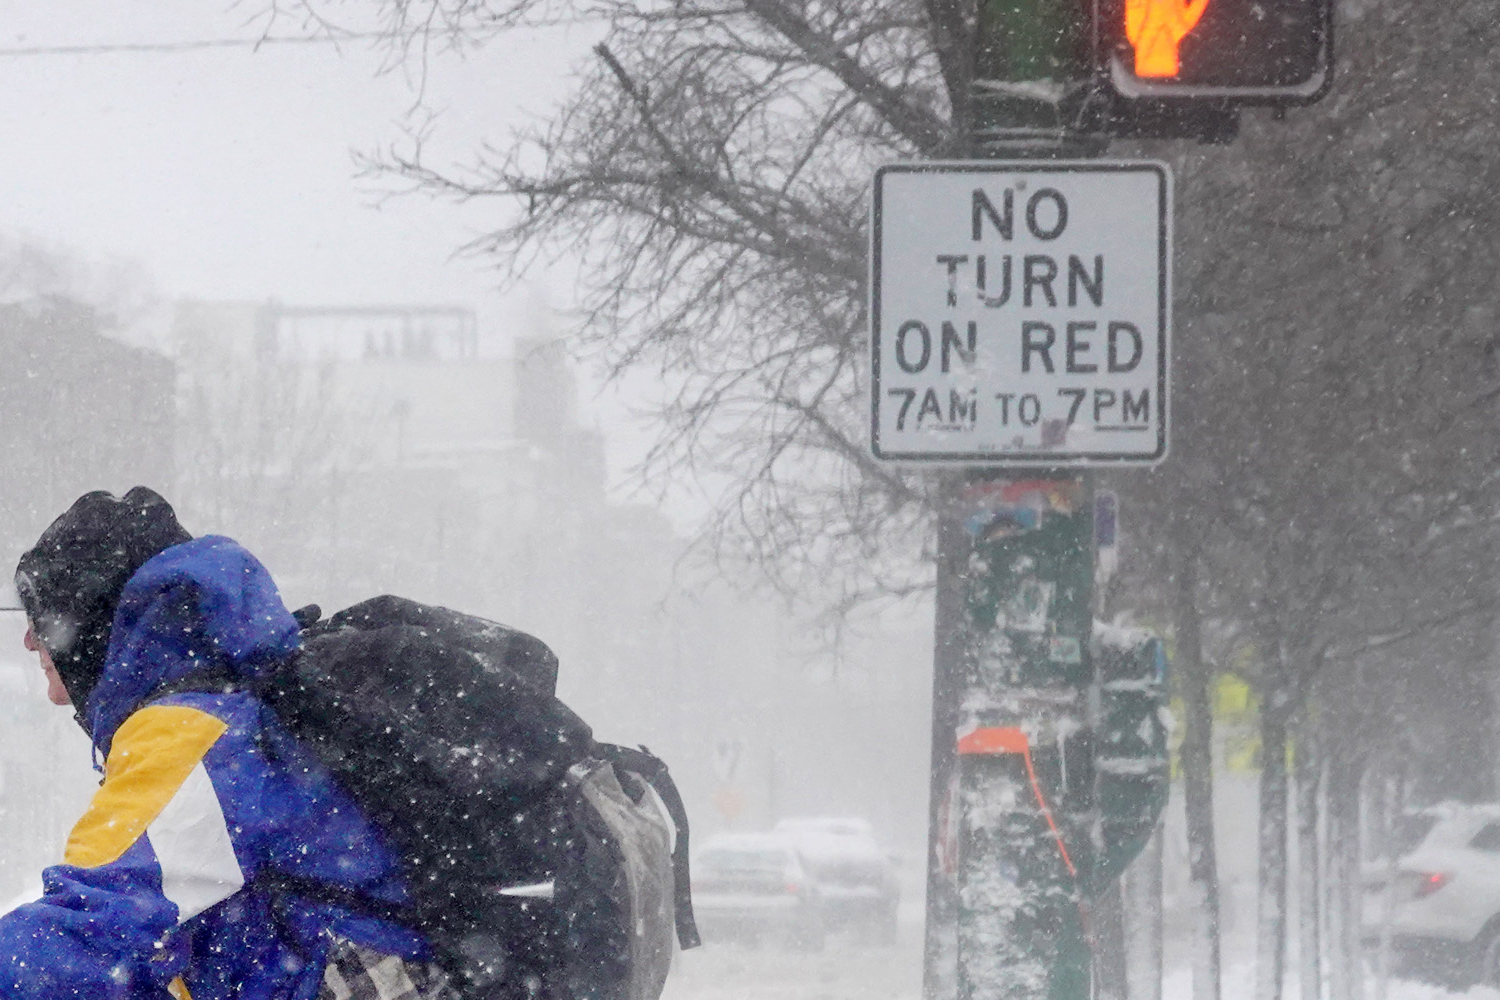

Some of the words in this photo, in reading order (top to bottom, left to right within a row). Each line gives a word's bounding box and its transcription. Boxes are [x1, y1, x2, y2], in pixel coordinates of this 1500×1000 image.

[972, 187, 1068, 241] NO
[936, 254, 1104, 308] TURN
[895, 319, 977, 373] ON
[1021, 320, 1143, 373] RED
[888, 387, 977, 430] 7AM
[996, 393, 1041, 426] TO
[1057, 387, 1149, 428] 7PM
